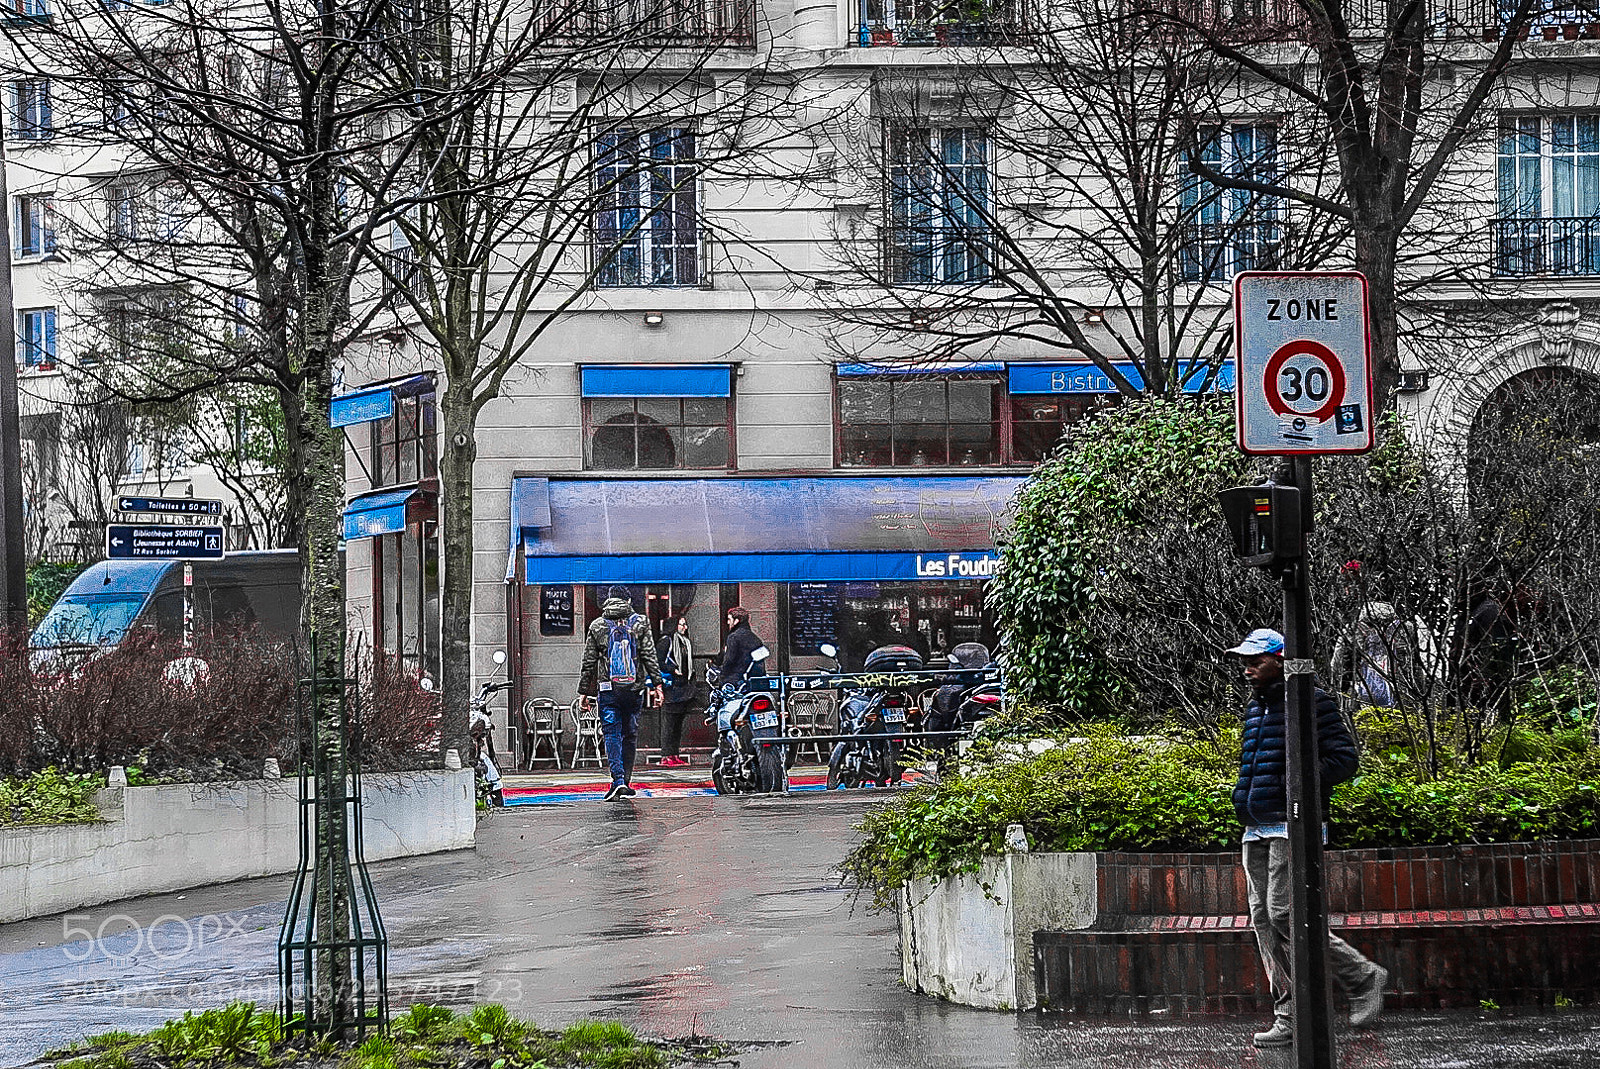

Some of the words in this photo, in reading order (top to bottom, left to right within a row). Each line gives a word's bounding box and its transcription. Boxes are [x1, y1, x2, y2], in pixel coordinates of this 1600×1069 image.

[1267, 299, 1338, 321] ZONE
[1281, 366, 1329, 402] 30
[148, 501, 179, 510] Toilettes
[181, 502, 186, 510] à
[189, 503, 199, 511] 50
[133, 530, 173, 539] Bibliothèque
[174, 530, 204, 538] SORBIER
[133, 539, 166, 548] (Jeunesse
[167, 539, 174, 547] et
[916, 555, 945, 576] Les
